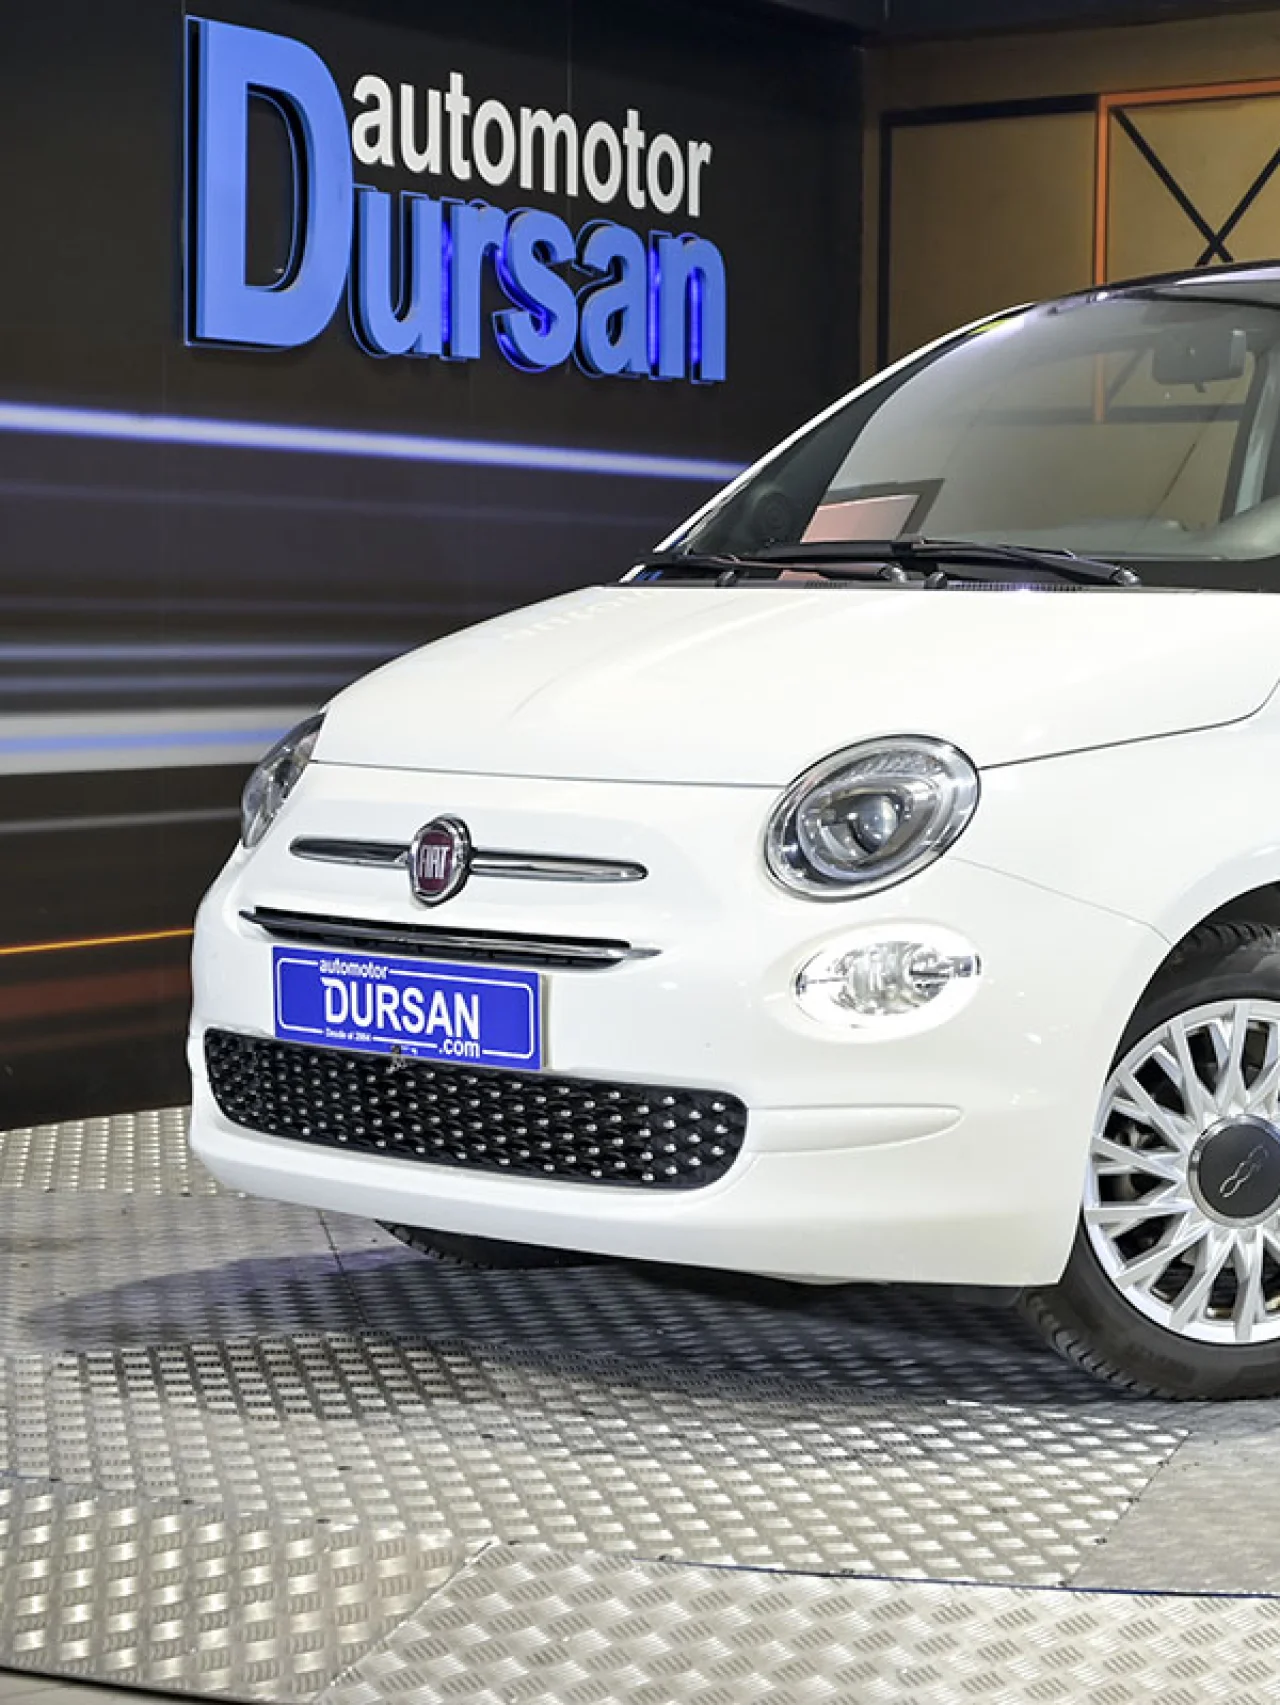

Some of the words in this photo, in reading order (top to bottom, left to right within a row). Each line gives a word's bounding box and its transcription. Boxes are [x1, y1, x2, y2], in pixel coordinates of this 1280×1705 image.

[352, 72, 712, 217] automotor
[185, 15, 727, 384] Dursan
[419, 844, 451, 880] FIAT
[319, 957, 389, 980] automotor
[320, 976, 480, 1041] DURSAN
[438, 1036, 481, 1059] .com
